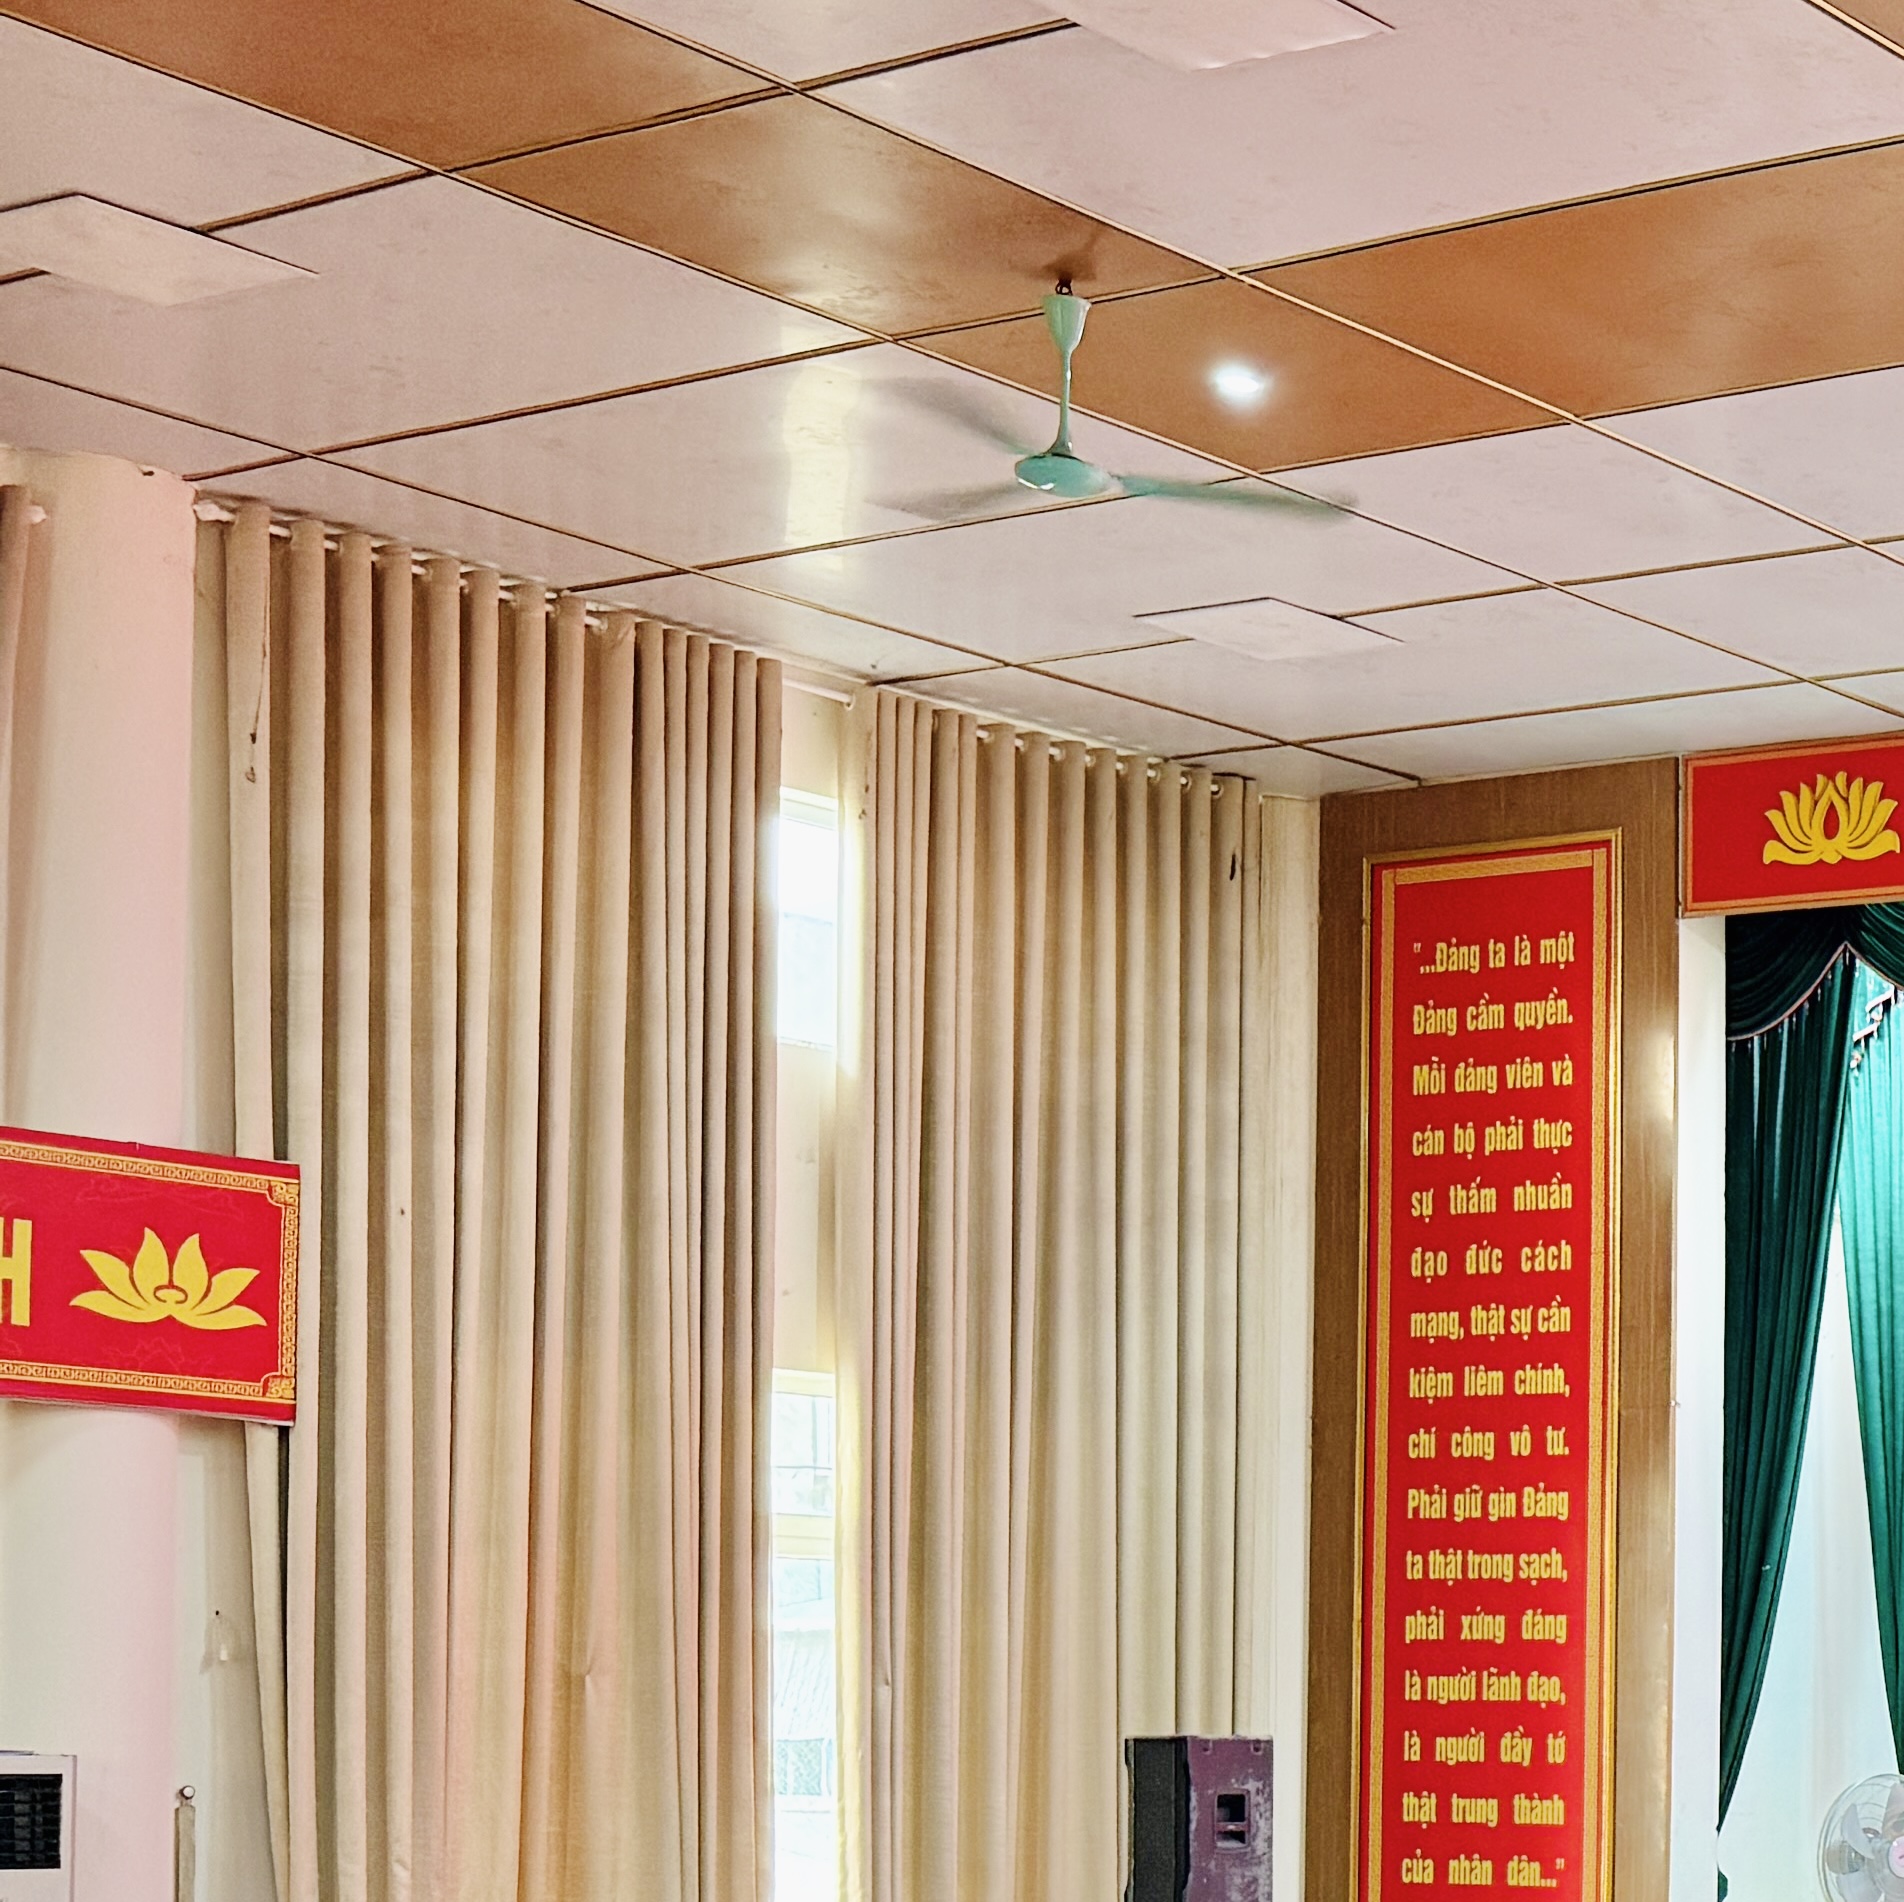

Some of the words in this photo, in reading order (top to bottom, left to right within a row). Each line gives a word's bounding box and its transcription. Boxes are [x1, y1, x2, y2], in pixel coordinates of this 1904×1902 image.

[1488, 938, 1506, 969] ta
[1514, 934, 1531, 966] là
[1539, 930, 1575, 970] một
[1413, 999, 1457, 1036] Đảng
[1466, 992, 1505, 1031] cầm
[1514, 986, 1574, 1031] quyền.
[1412, 1124, 1445, 1156] cán
[1453, 1121, 1475, 1160] bộ
[1484, 1115, 1524, 1156] phải
[1532, 1117, 1573, 1155] thực
[1411, 1246, 1448, 1283] đạo
[1465, 1239, 1503, 1275] đức
[1520, 1239, 1572, 1273] cách
[1410, 1311, 1465, 1344] mạng,
[1470, 1303, 1506, 1342] thật
[1510, 1305, 1534, 1341] sự
[1537, 1294, 1571, 1334] cần
[1409, 1366, 1454, 1405] kiệm
[1463, 1364, 1504, 1397] liêm
[1514, 1362, 1570, 1398] chính,
[1408, 1426, 1436, 1459] chí
[1451, 1425, 1495, 1461] công
[1509, 1424, 1532, 1457] vô
[1545, 1425, 1570, 1456] tư.
[1406, 1550, 1423, 1580] ta
[1428, 1548, 1463, 1586] thật
[1467, 1549, 1514, 1583] trong
[1518, 1547, 1568, 1586] sạch,
[1405, 1605, 1444, 1644] phải
[1460, 1605, 1506, 1644] xứng
[1521, 1608, 1567, 1645] đáng
[1402, 1790, 1437, 1829] thật
[1451, 1793, 1499, 1828] trung
[1513, 1792, 1565, 1826] thành
[1401, 1848, 1434, 1884] của
[1448, 1853, 1493, 1886] nhân
